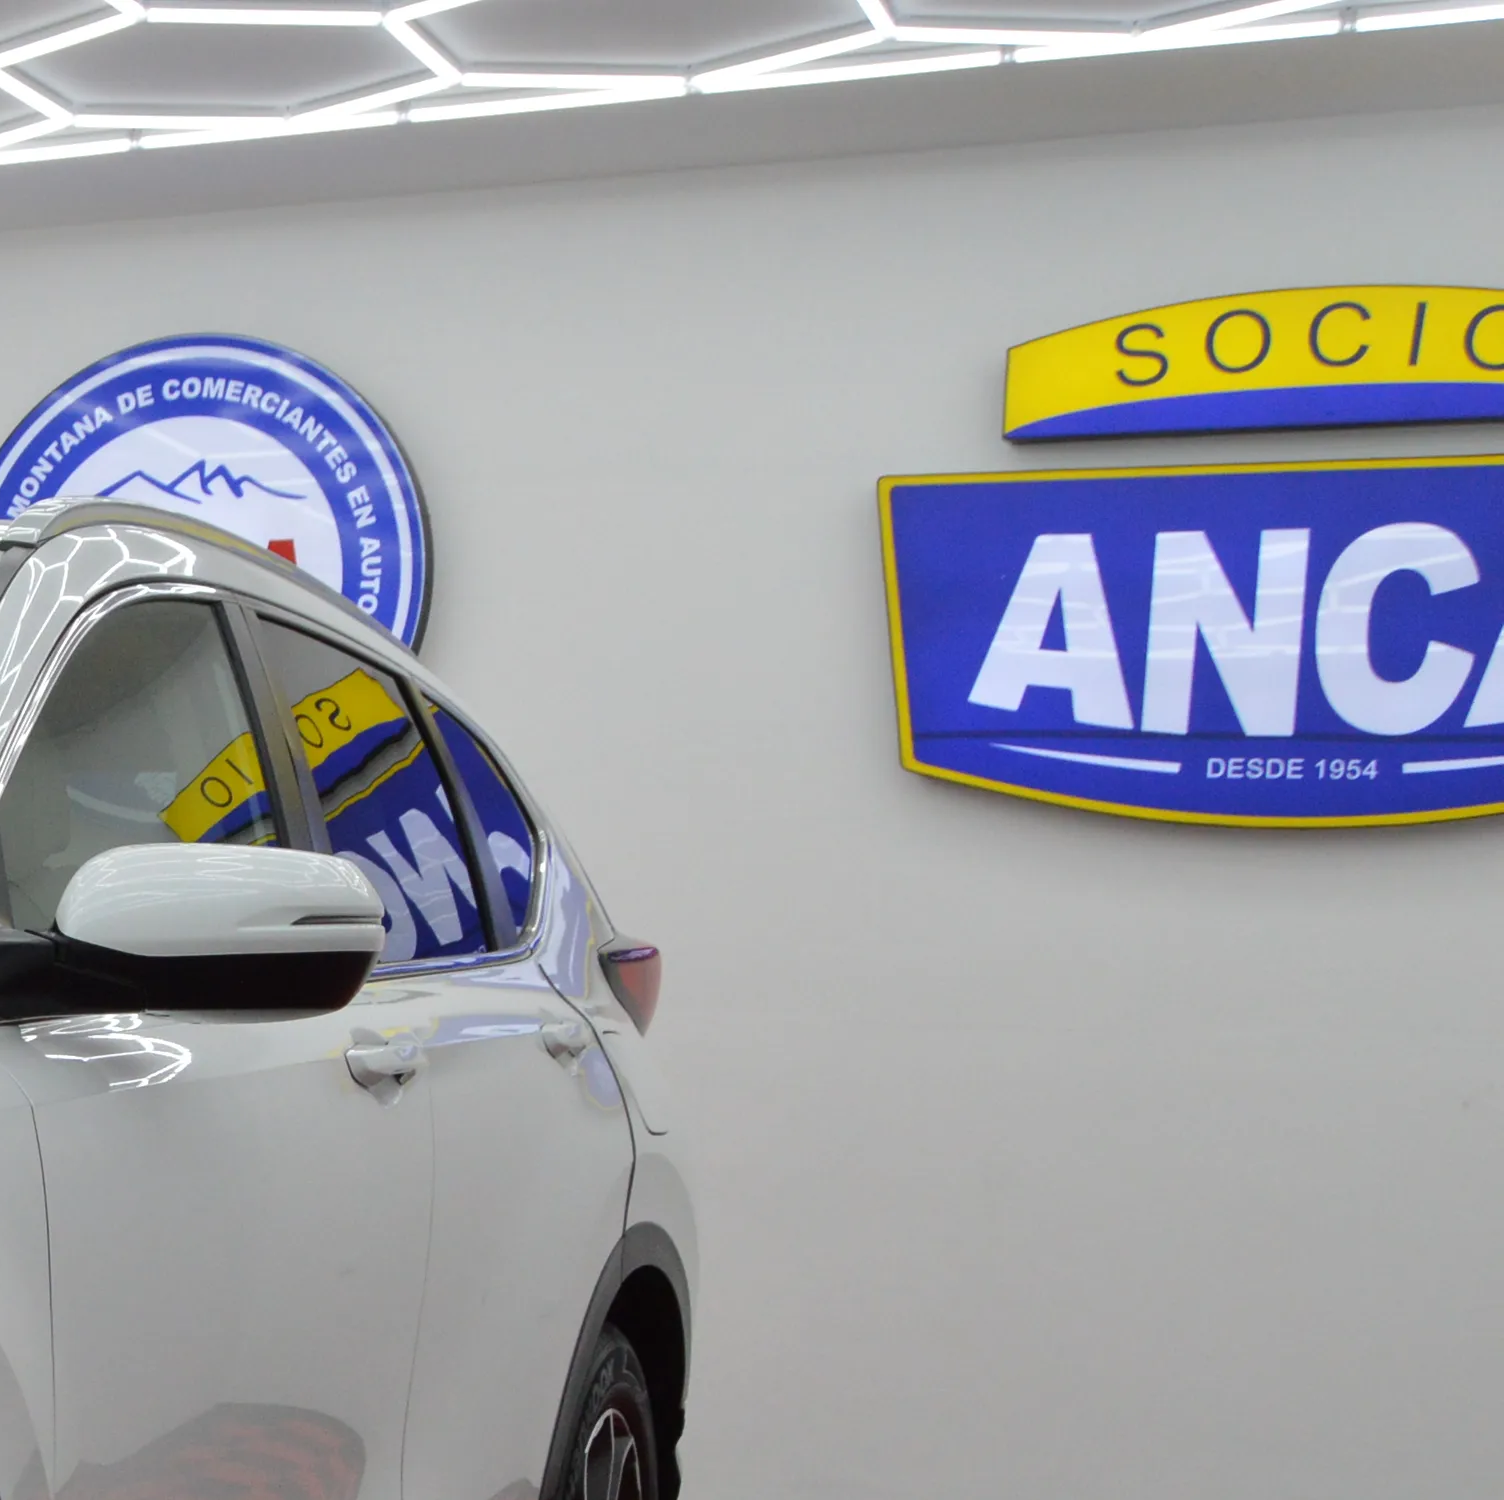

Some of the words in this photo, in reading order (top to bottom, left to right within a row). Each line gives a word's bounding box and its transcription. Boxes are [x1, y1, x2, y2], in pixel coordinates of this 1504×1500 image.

[1113, 300, 1504, 388] SOCIO
[116, 383, 155, 414] DE
[161, 376, 356, 485] COMERCIANTES
[346, 484, 377, 529] EN
[357, 536, 383, 616] AUTO
[967, 521, 1504, 738] ANC
[1205, 756, 1304, 780] DESDE
[1314, 759, 1380, 781] 1954
